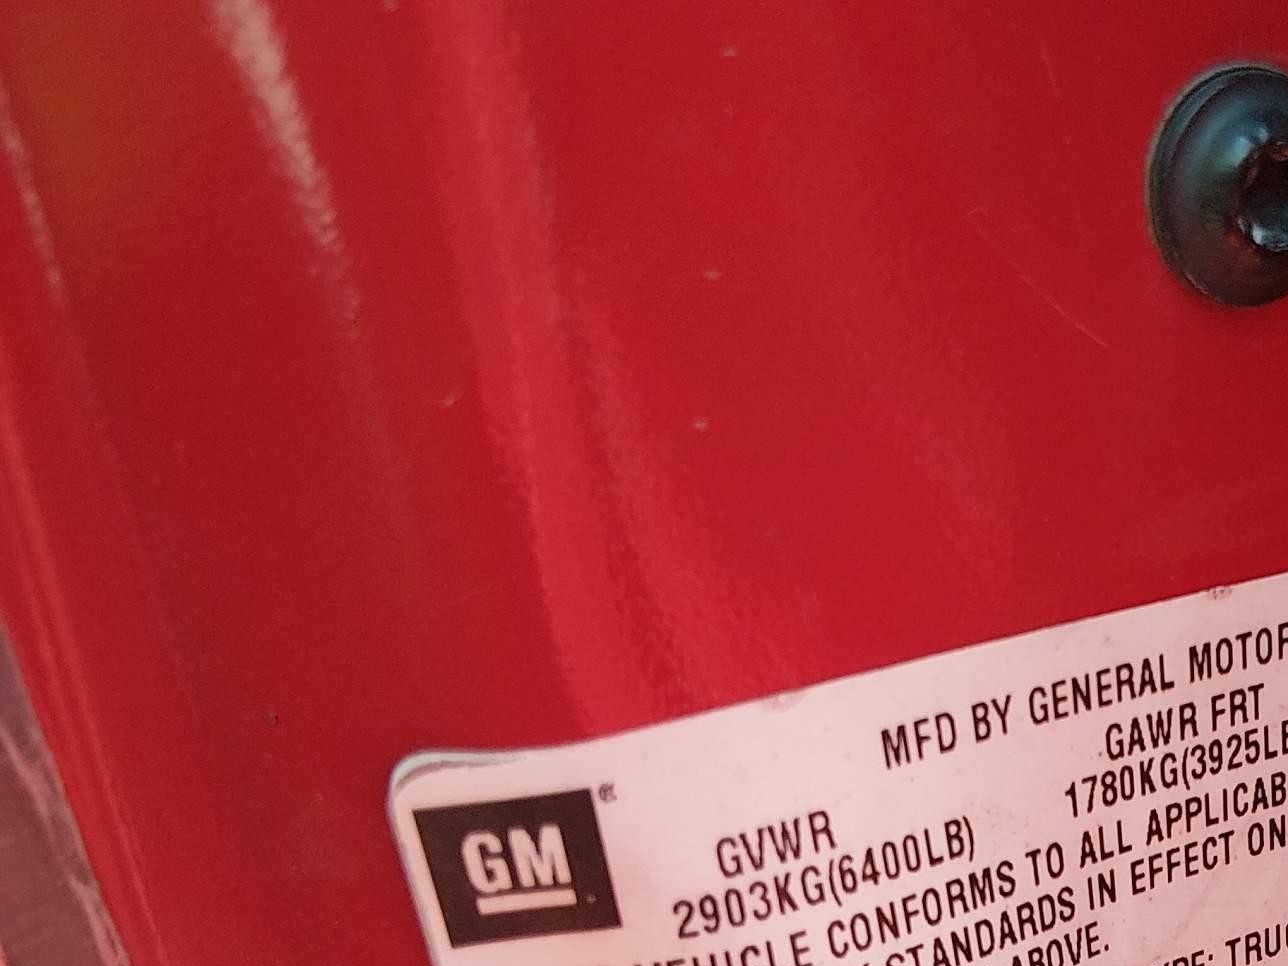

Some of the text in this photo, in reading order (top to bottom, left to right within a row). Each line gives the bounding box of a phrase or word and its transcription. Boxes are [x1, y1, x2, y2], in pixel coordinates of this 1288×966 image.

[880, 711, 958, 770] MFD
[970, 693, 1012, 744] BY
[1028, 653, 1176, 726] GENERAL
[1104, 682, 1265, 762] GAWR FRT
[460, 822, 573, 894] GM
[672, 815, 975, 940] 2903KG(6400LB)
[716, 810, 837, 879] GVWR
[826, 859, 1017, 959] CONFORMS
[1024, 841, 1065, 887] TO
[1079, 819, 1133, 870] ALL
[1086, 867, 1117, 911] IN
[1129, 829, 1236, 896] EFFECT
[1247, 813, 1287, 857] ON
